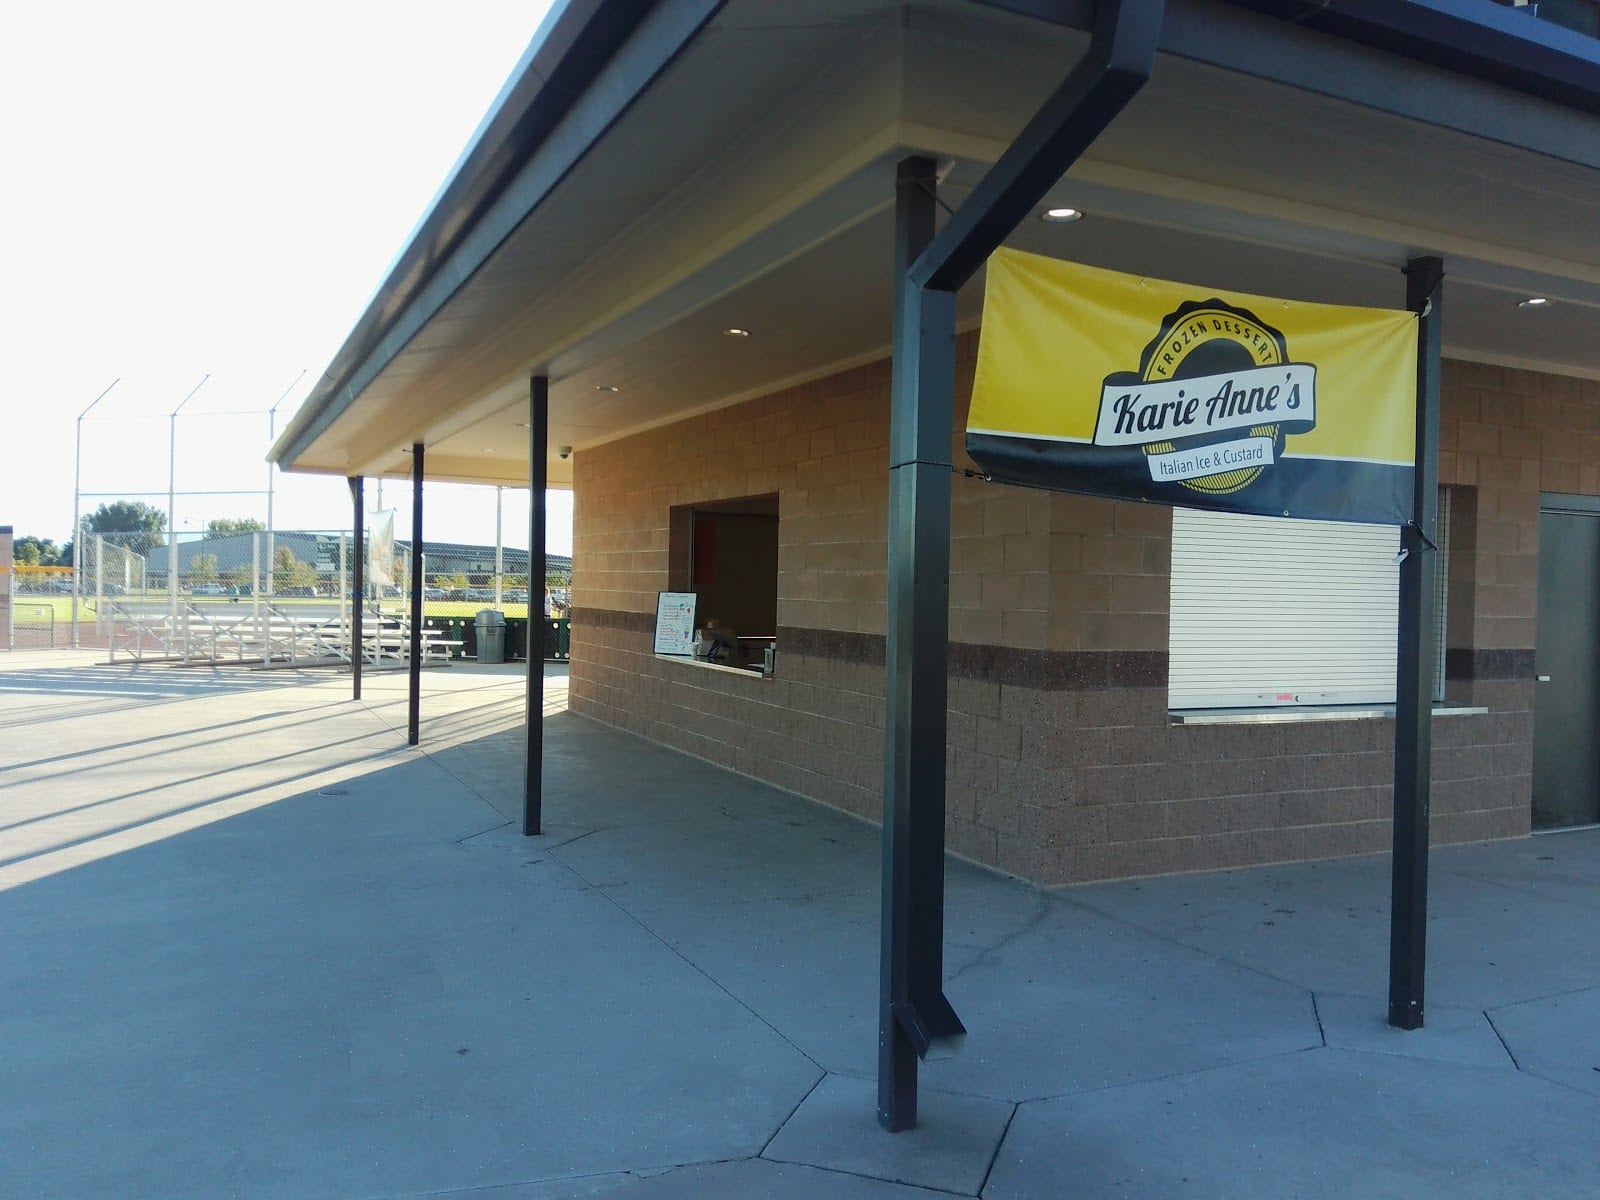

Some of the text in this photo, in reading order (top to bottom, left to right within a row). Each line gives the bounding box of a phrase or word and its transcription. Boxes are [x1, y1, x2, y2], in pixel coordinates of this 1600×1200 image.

[1157, 319, 1272, 376] FROZEN DESSERT
[1113, 372, 1301, 434] Karie Anne's
[1160, 443, 1264, 476] Italian Ice & Custard
